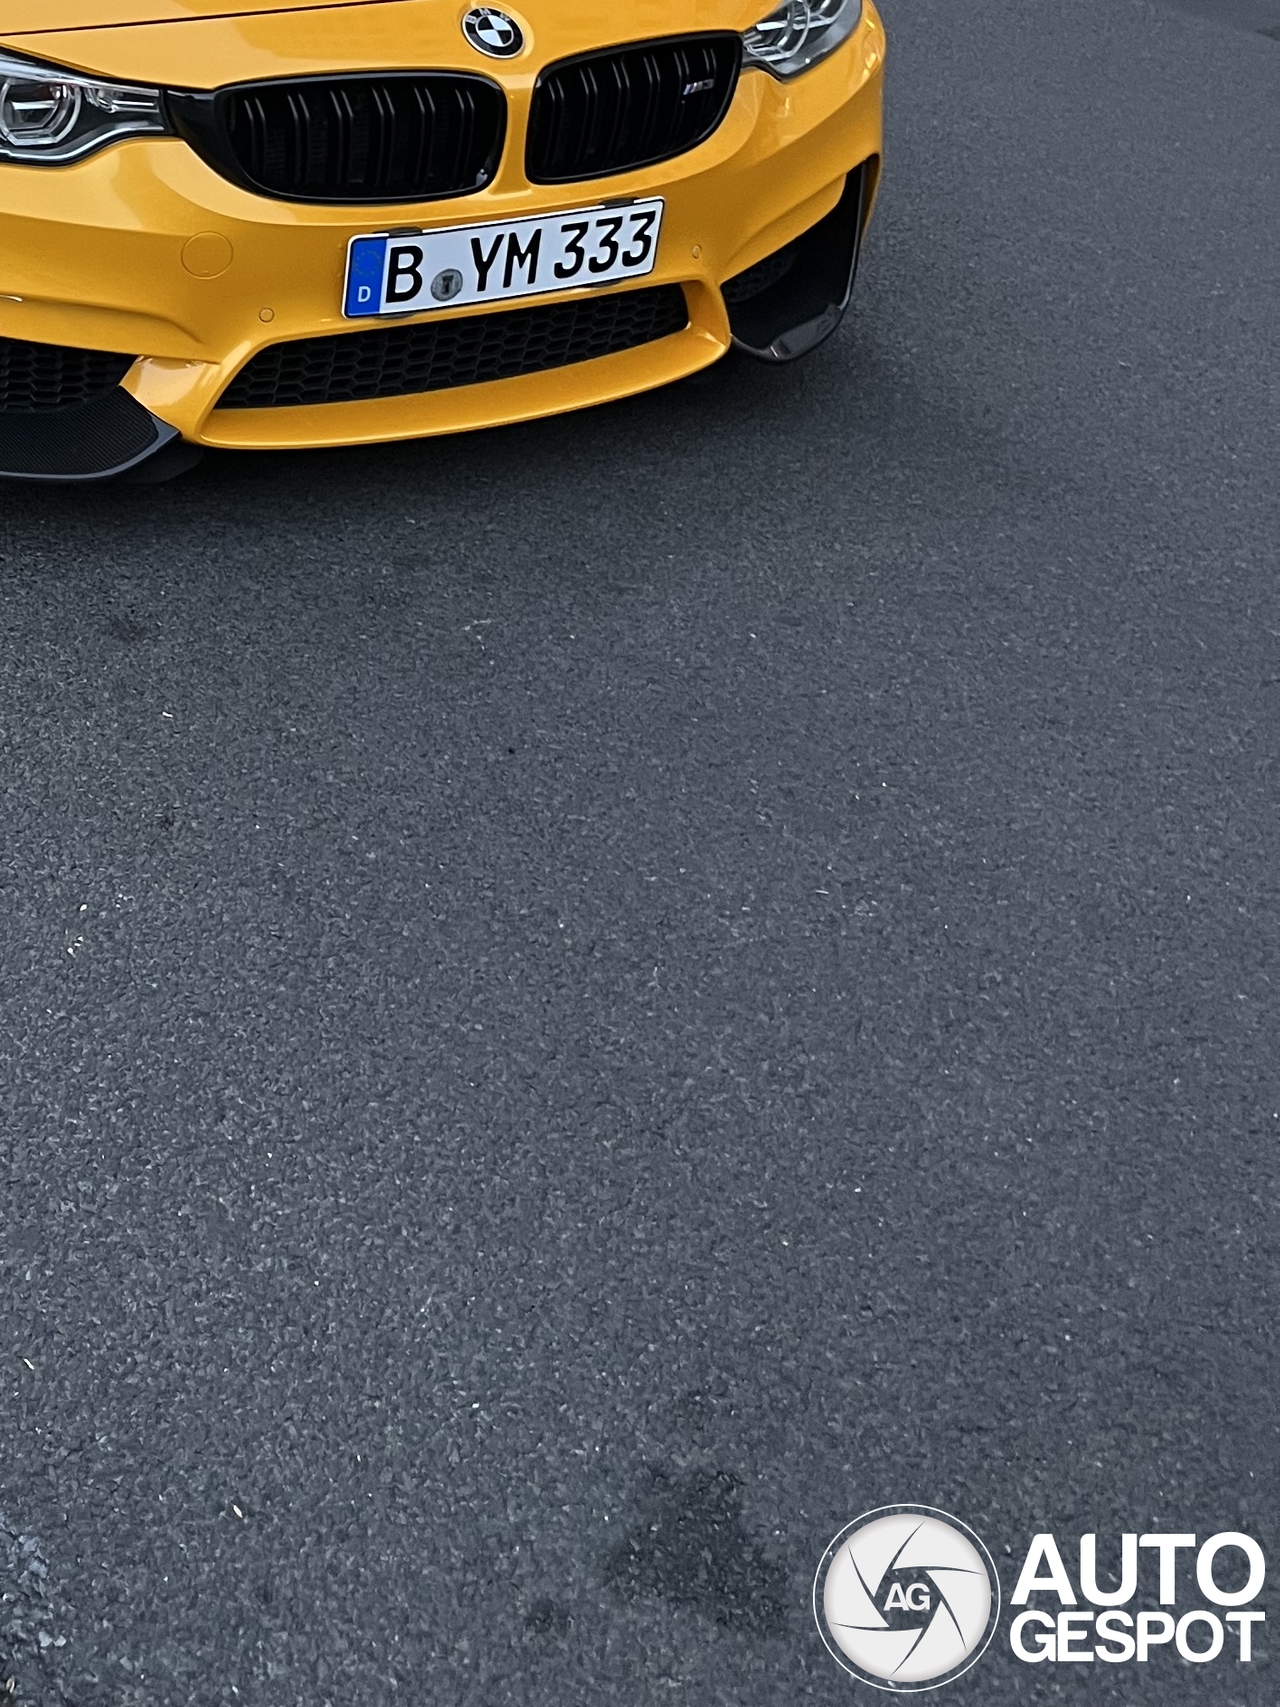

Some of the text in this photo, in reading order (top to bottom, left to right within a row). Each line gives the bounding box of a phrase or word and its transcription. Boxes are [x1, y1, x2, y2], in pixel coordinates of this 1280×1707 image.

[465, 8, 511, 25] BMW
[357, 211, 657, 303] D B YM 333
